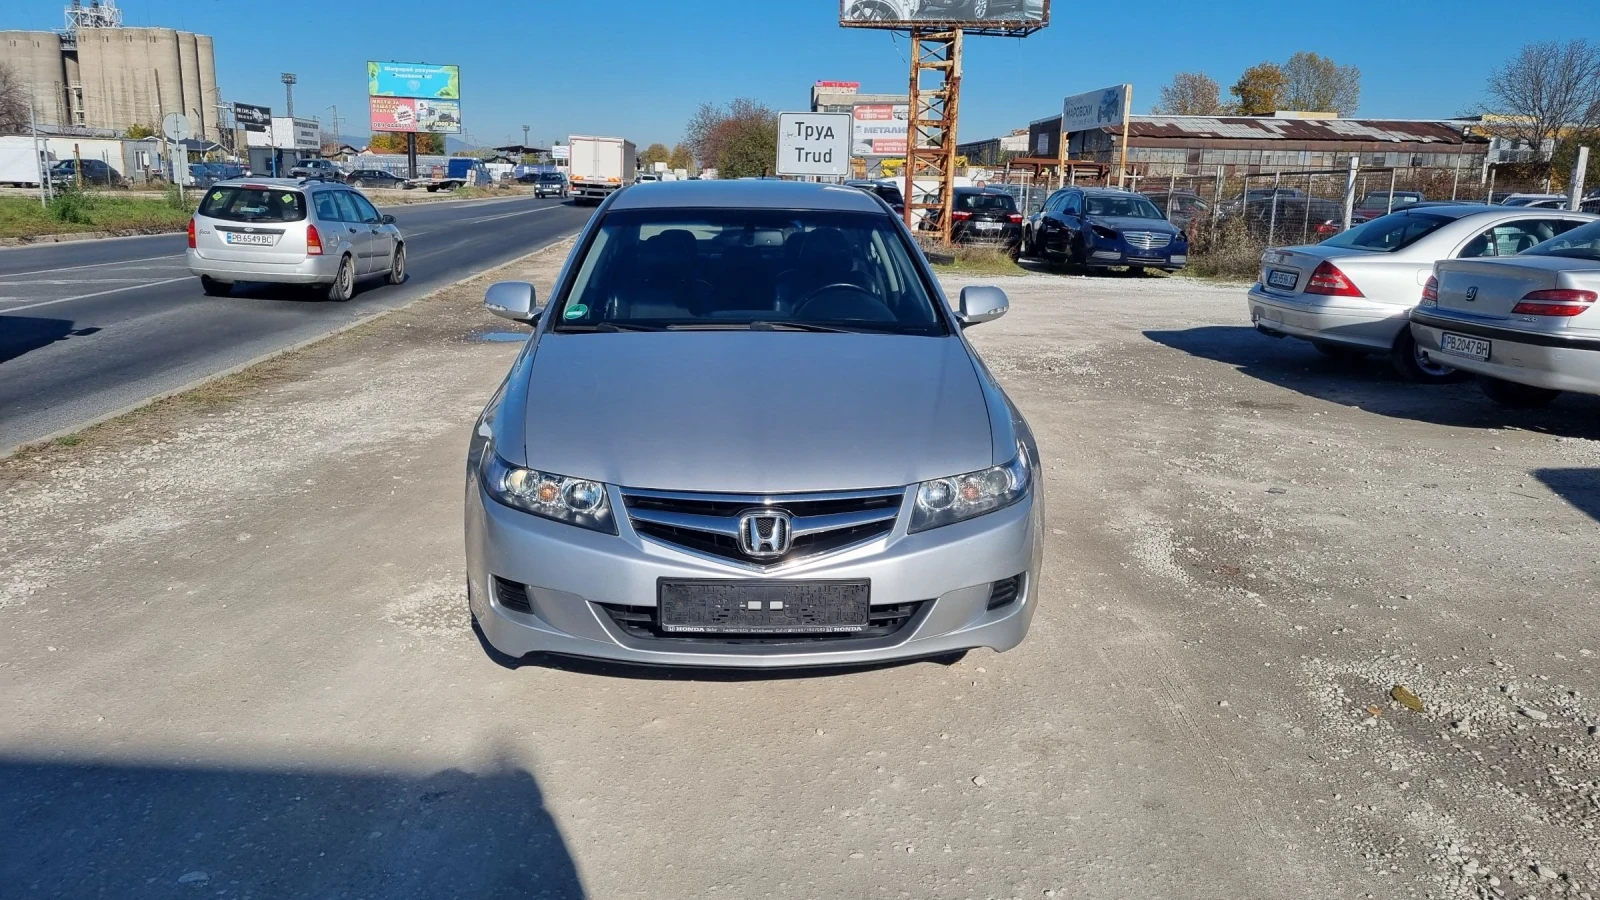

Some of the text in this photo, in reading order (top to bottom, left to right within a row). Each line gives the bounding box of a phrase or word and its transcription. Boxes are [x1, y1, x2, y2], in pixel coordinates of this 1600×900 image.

[795, 121, 835, 141] Труд
[795, 147, 832, 163] Trud
[232, 234, 272, 244] PB 6549 BC
[1446, 335, 1456, 349] PB
[1455, 338, 1476, 353] 2047
[1476, 342, 1489, 356] BH
